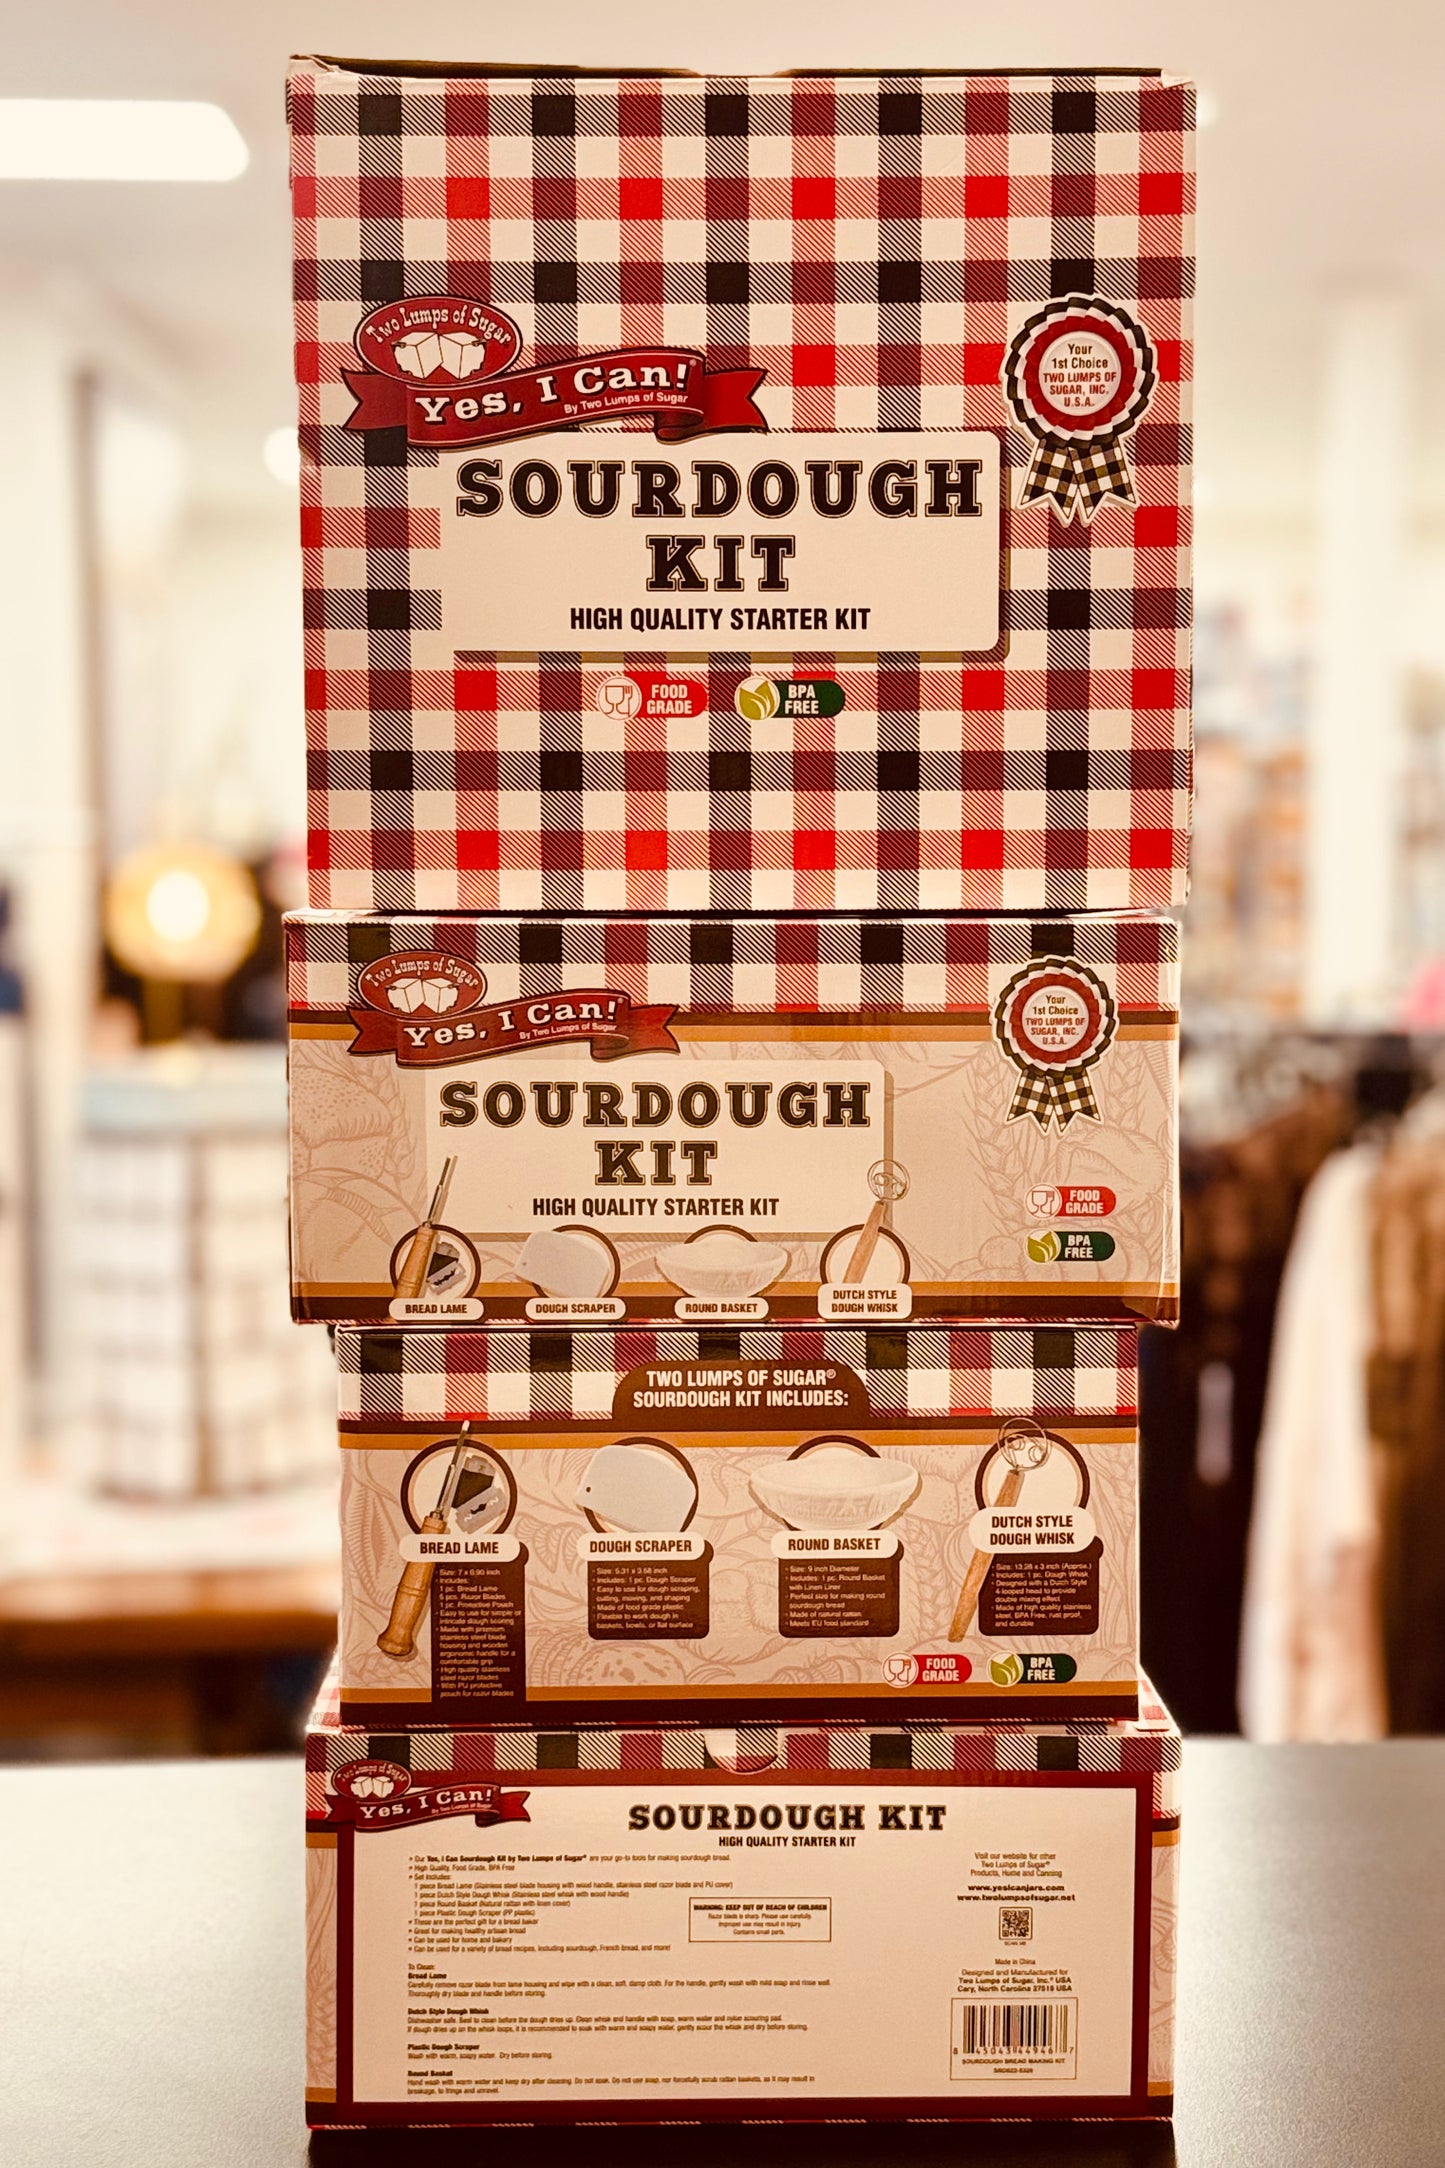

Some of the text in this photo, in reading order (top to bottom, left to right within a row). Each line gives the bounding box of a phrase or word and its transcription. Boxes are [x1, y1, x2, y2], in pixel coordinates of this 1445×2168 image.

[366, 305, 512, 344] Two Lumps of Sugar
[1067, 343, 1092, 355] Your
[1052, 357, 1108, 369] 1st Choice
[1043, 372, 1117, 383] TWO LUMPS OF
[1050, 384, 1109, 396] SUGAR, INC.
[415, 391, 522, 422] Yes,
[536, 376, 557, 402] I
[564, 392, 688, 414] By Two Lumps of Sugar
[1064, 397, 1095, 407] U.S.A.
[456, 458, 983, 519] SOURDOUGH
[645, 534, 796, 592] KIT
[570, 607, 872, 633] HIGH QUALITY STARTER KIT
[651, 685, 689, 699] FOOD
[788, 685, 816, 699] BPA
[647, 699, 693, 715] GRADE
[784, 699, 820, 715] FREE
[366, 957, 479, 987] Two Lumps of Sugar
[1046, 995, 1066, 1004] Your
[1033, 1006, 1078, 1015] 1st Choice
[1025, 1018, 1044, 1026] TWO
[1075, 1017, 1085, 1025] OF
[403, 1022, 487, 1046] Yes,
[498, 1010, 515, 1031] I
[519, 1022, 617, 1040] By Two Lumps of Sugar
[1031, 1027, 1079, 1036] SUGAR, INC.
[1042, 1037, 1067, 1045] U.S.A.
[440, 1081, 871, 1129] SOURDOUGH
[594, 1140, 718, 1186] KIT
[1069, 1190, 1100, 1202] FOOD
[533, 1197, 779, 1218] HIGH QUALITY STARTER KIT
[1065, 1202, 1104, 1214] GRADE
[1067, 1234, 1091, 1246] BPA
[1064, 1247, 1094, 1259] FREE
[833, 1289, 897, 1300] DUTCH STYLE
[405, 1304, 467, 1314] BREAD LAME
[535, 1303, 616, 1313] DOUGH SCRAPER
[685, 1303, 758, 1313] ROUND BASKET
[831, 1303, 898, 1313] DOUGH WHISK
[646, 1370, 682, 1387] TWO
[687, 1370, 743, 1387] LUMPS
[748, 1370, 768, 1386] OF
[633, 1389, 849, 1408] SOURDOUGH KIT INCLUDES:
[992, 1515, 1073, 1528] DUTCH STYLE
[788, 1537, 881, 1551] ROUND BASKET
[990, 1532, 1074, 1545] DOUGH WHISK
[420, 1541, 499, 1555] BREAD LAME
[590, 1539, 692, 1553] DOUGH SCRAPER
[829, 1565, 860, 1573] Diameter
[926, 1658, 956, 1669] FOOD
[1030, 1657, 1053, 1669] BPA
[922, 1670, 960, 1682] GRADE
[1027, 1669, 1056, 1681] FREE
[360, 1803, 411, 1819] Yes,
[419, 1796, 429, 1808] I
[628, 1803, 947, 1831] SOURDOUGH KIT
[718, 1836, 856, 1848] HIGH QUALITY STARTER KIT
[974, 1852, 988, 1860] Visit
[1002, 1852, 1027, 1860] website
[1029, 1852, 1038, 1860] for
[1039, 1852, 1056, 1860] other
[995, 1861, 1017, 1869] Lumps
[970, 1869, 1000, 1877] Products,
[1022, 1869, 1034, 1877] and
[1036, 1869, 1062, 1878] Canning
[975, 1977, 1000, 1985] Lumps
